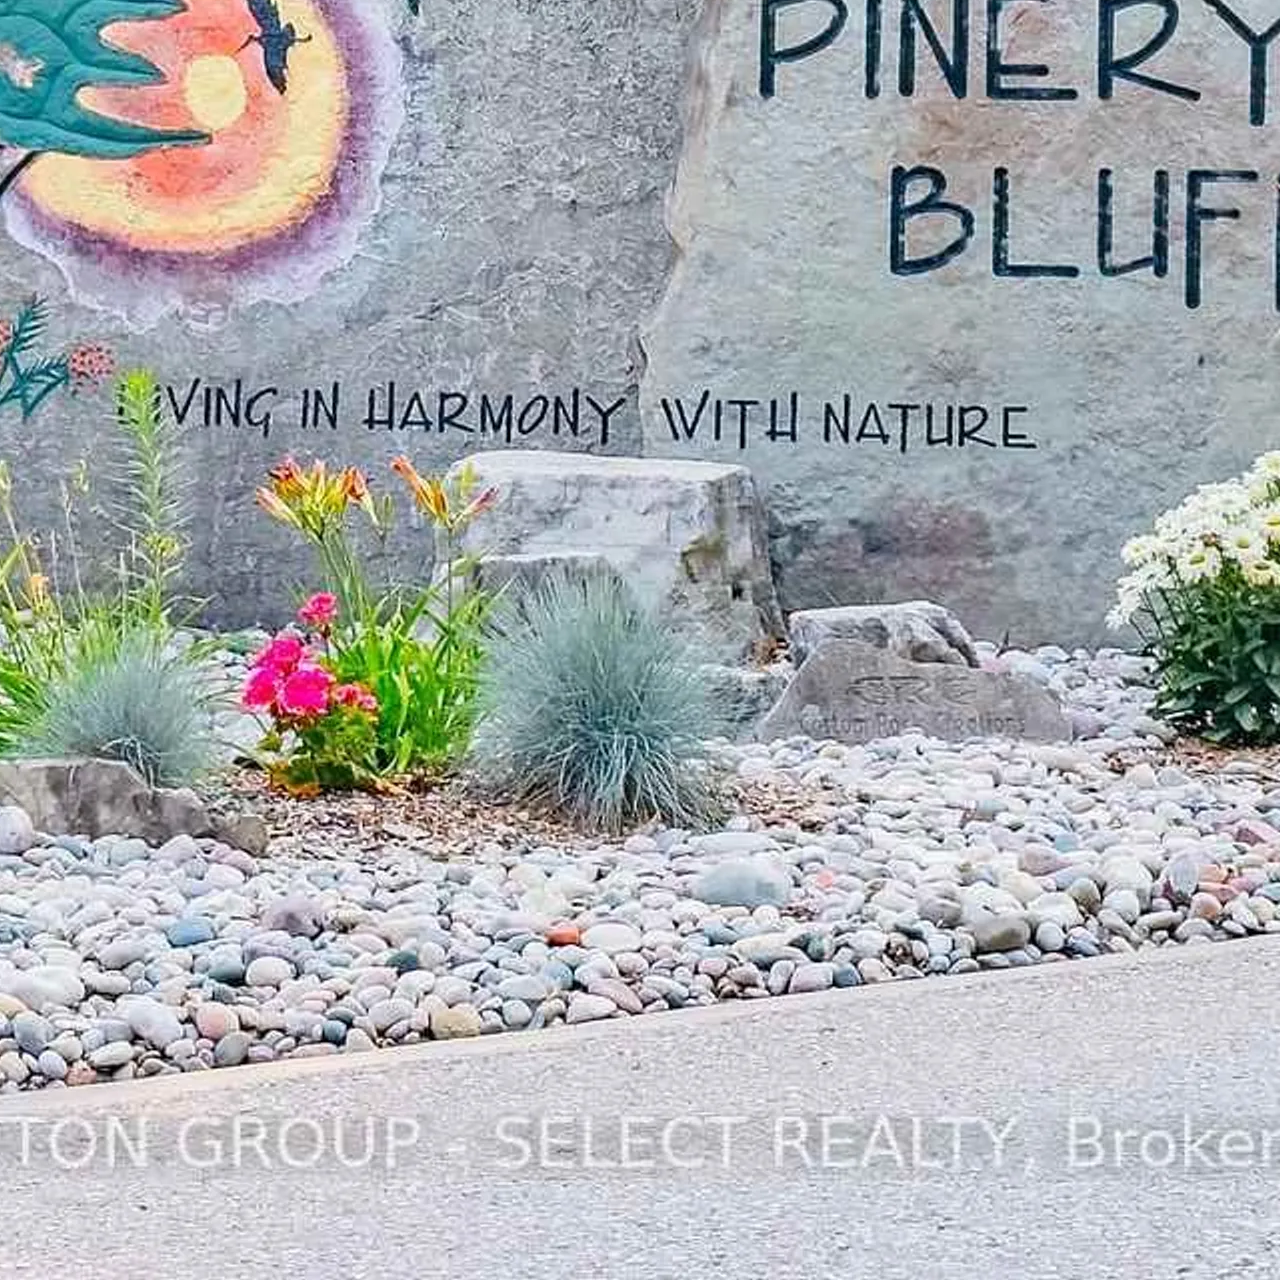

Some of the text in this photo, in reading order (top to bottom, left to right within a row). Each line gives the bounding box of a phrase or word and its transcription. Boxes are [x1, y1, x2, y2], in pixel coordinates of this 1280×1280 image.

[302, 381, 340, 431] IN
[363, 380, 625, 444] HARMONY
[660, 389, 798, 450] WITH
[822, 393, 1038, 454] NATURE
